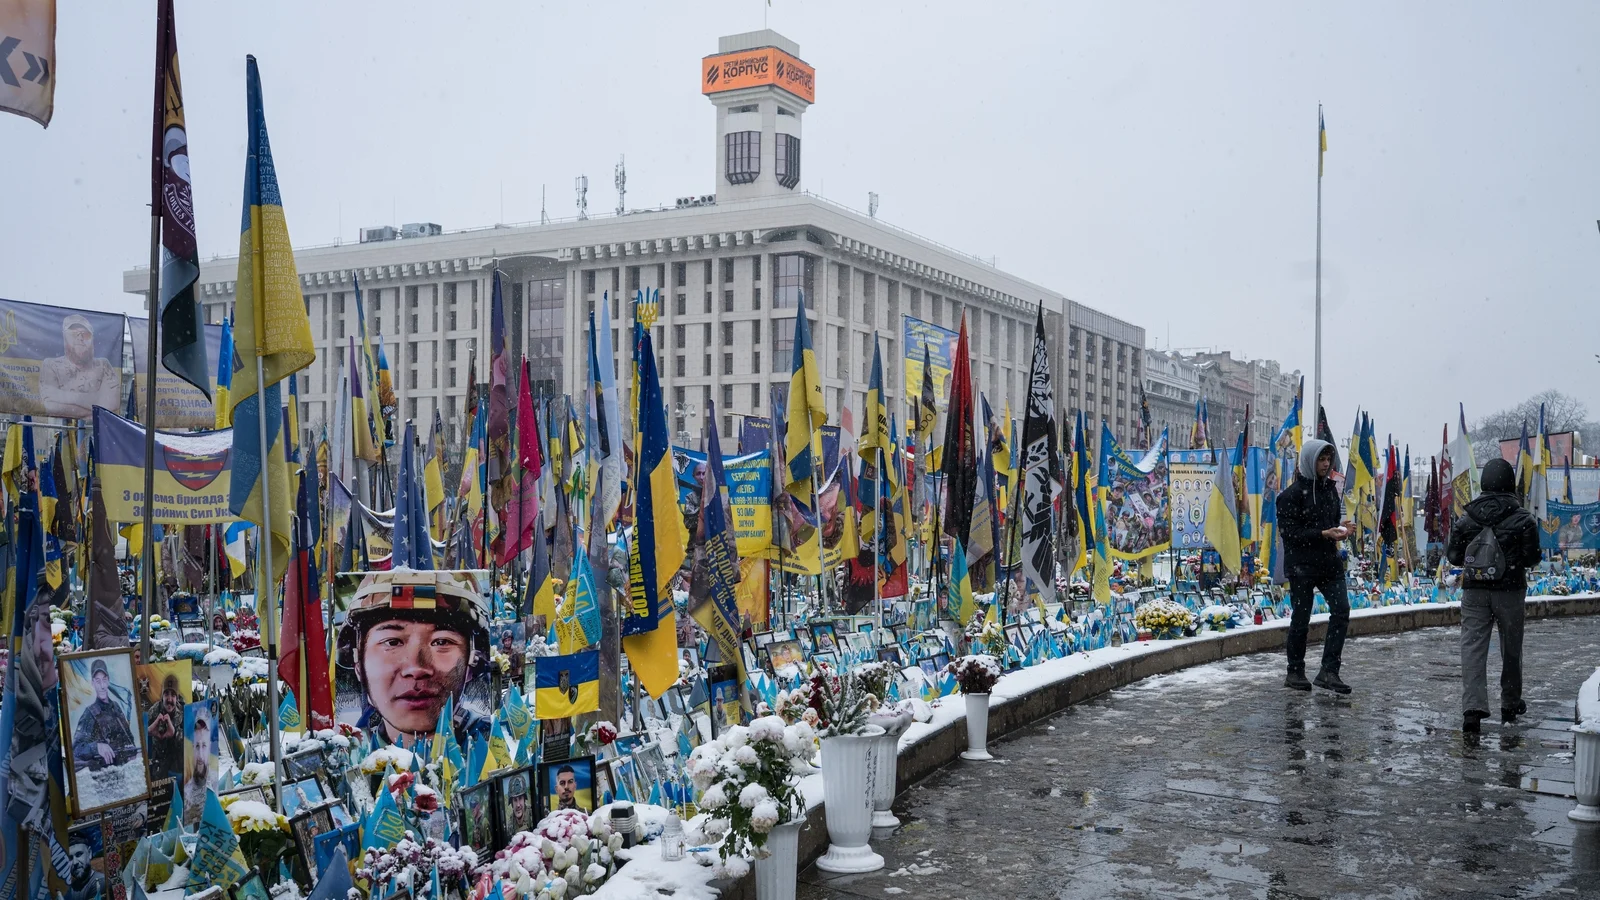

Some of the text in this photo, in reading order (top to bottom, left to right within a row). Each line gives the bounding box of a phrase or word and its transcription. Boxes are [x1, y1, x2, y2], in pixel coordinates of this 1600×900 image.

[723, 62, 768, 79] КОРПУС
[786, 70, 812, 90] КОРПУС
[176, 493, 225, 506] бригада
[190, 508, 213, 519] Сил
[631, 586, 650, 618] ІГОР
